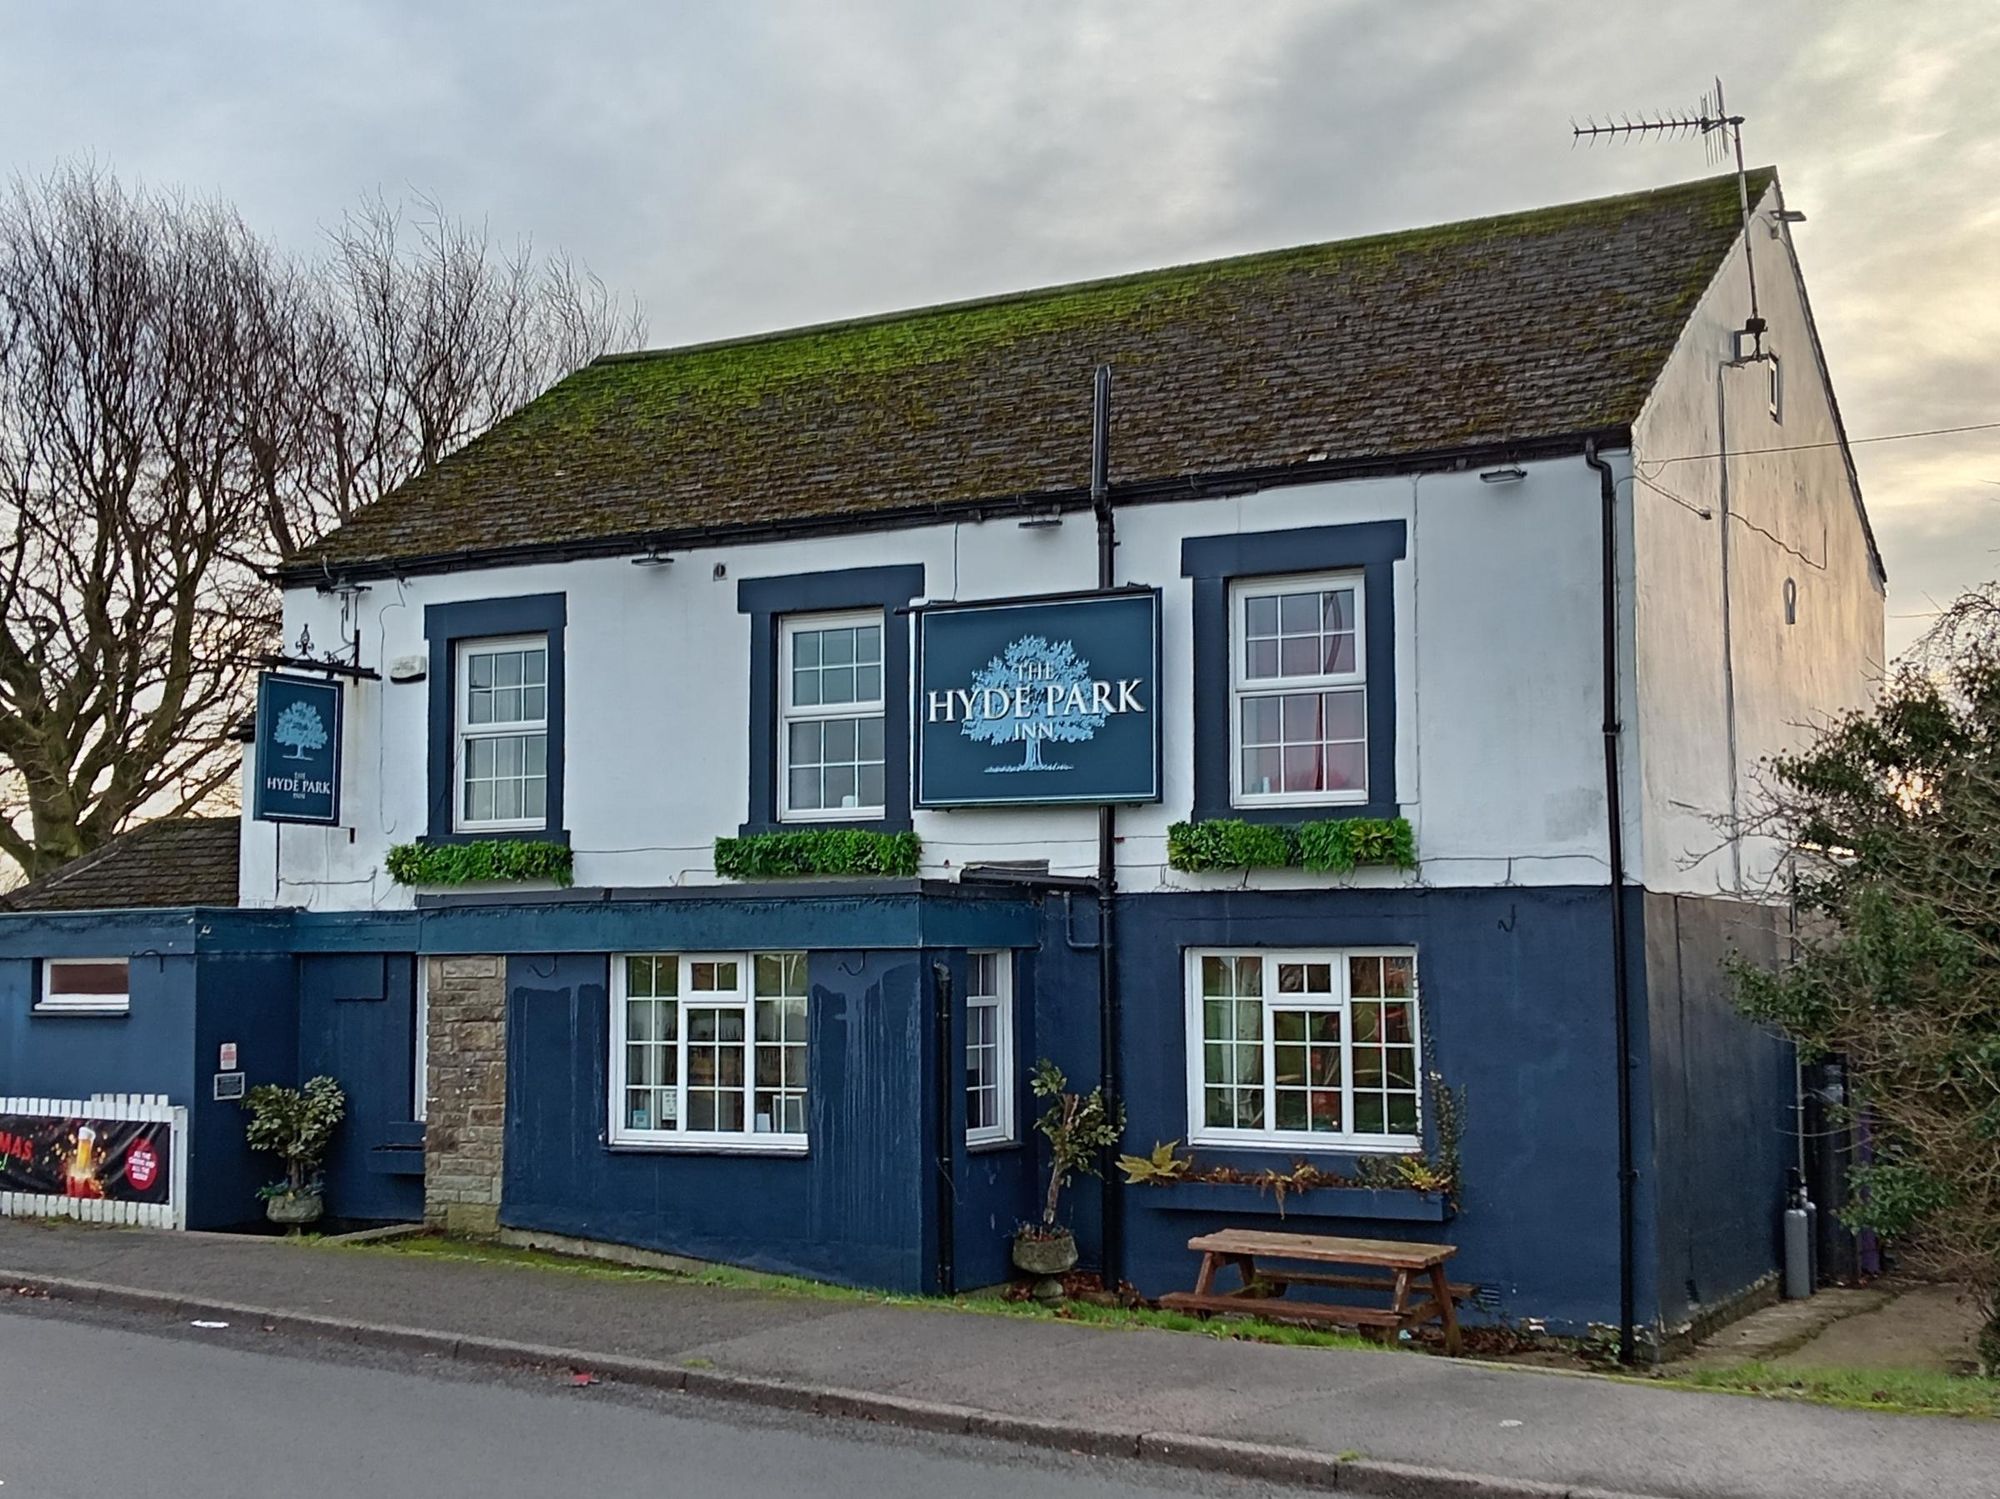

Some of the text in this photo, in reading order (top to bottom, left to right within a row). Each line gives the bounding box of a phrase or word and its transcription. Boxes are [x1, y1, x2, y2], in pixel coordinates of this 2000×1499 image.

[1017, 661, 1055, 680] THE
[927, 679, 1146, 722] HYDE PARK
[1014, 721, 1055, 740] INN
[267, 776, 330, 794] HYDE PARK
